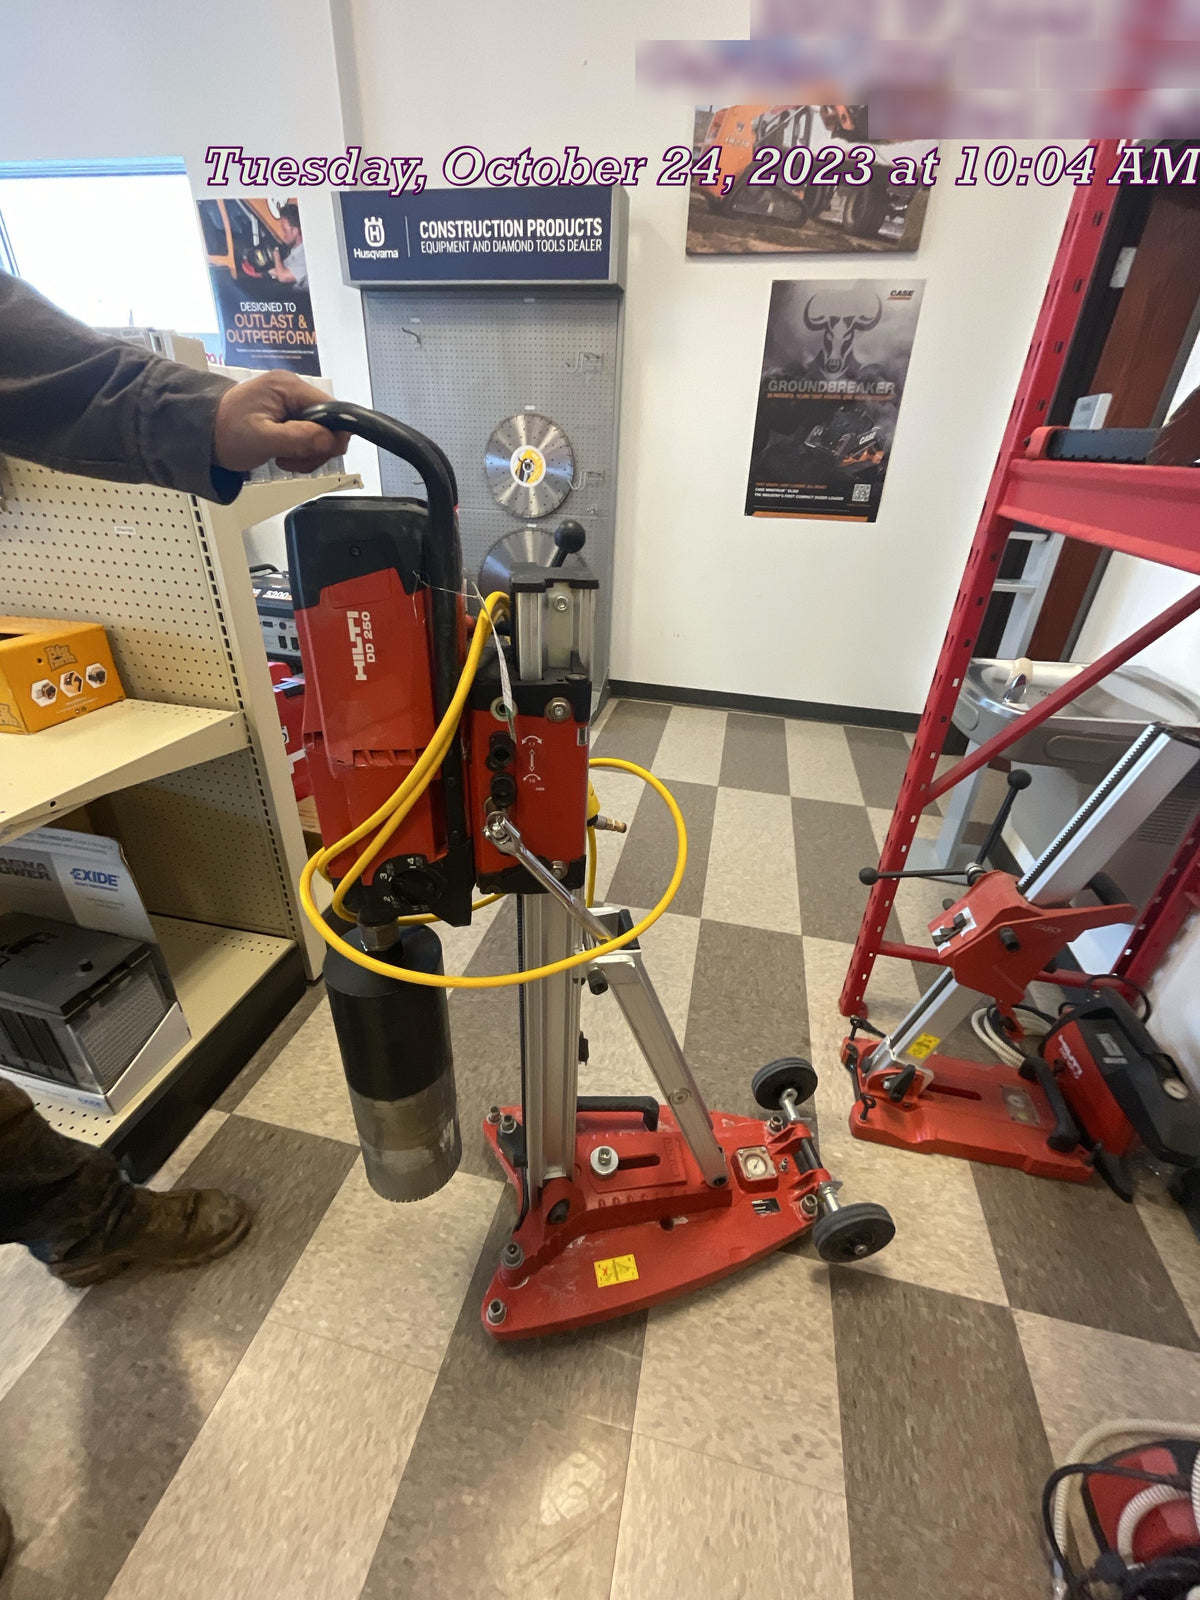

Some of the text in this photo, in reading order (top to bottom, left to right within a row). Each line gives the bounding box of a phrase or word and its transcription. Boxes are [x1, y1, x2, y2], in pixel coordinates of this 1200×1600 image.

[419, 217, 602, 238] CONSTRUCTION PRODUCTS
[353, 248, 399, 260] Husqvarna
[421, 238, 602, 254] EQUIPMENT AND DIAMOND TOOLS DEALER
[890, 289, 914, 297] CASE
[240, 302, 297, 312] DESIGNED TO
[234, 313, 308, 329] OUTLAST &
[226, 329, 317, 345] OUTPERFORM
[767, 380, 896, 395] GROUNDBREAKER
[361, 611, 376, 663] DD 250
[346, 611, 367, 681] HILTI
[70, 867, 120, 887] EXIDE
